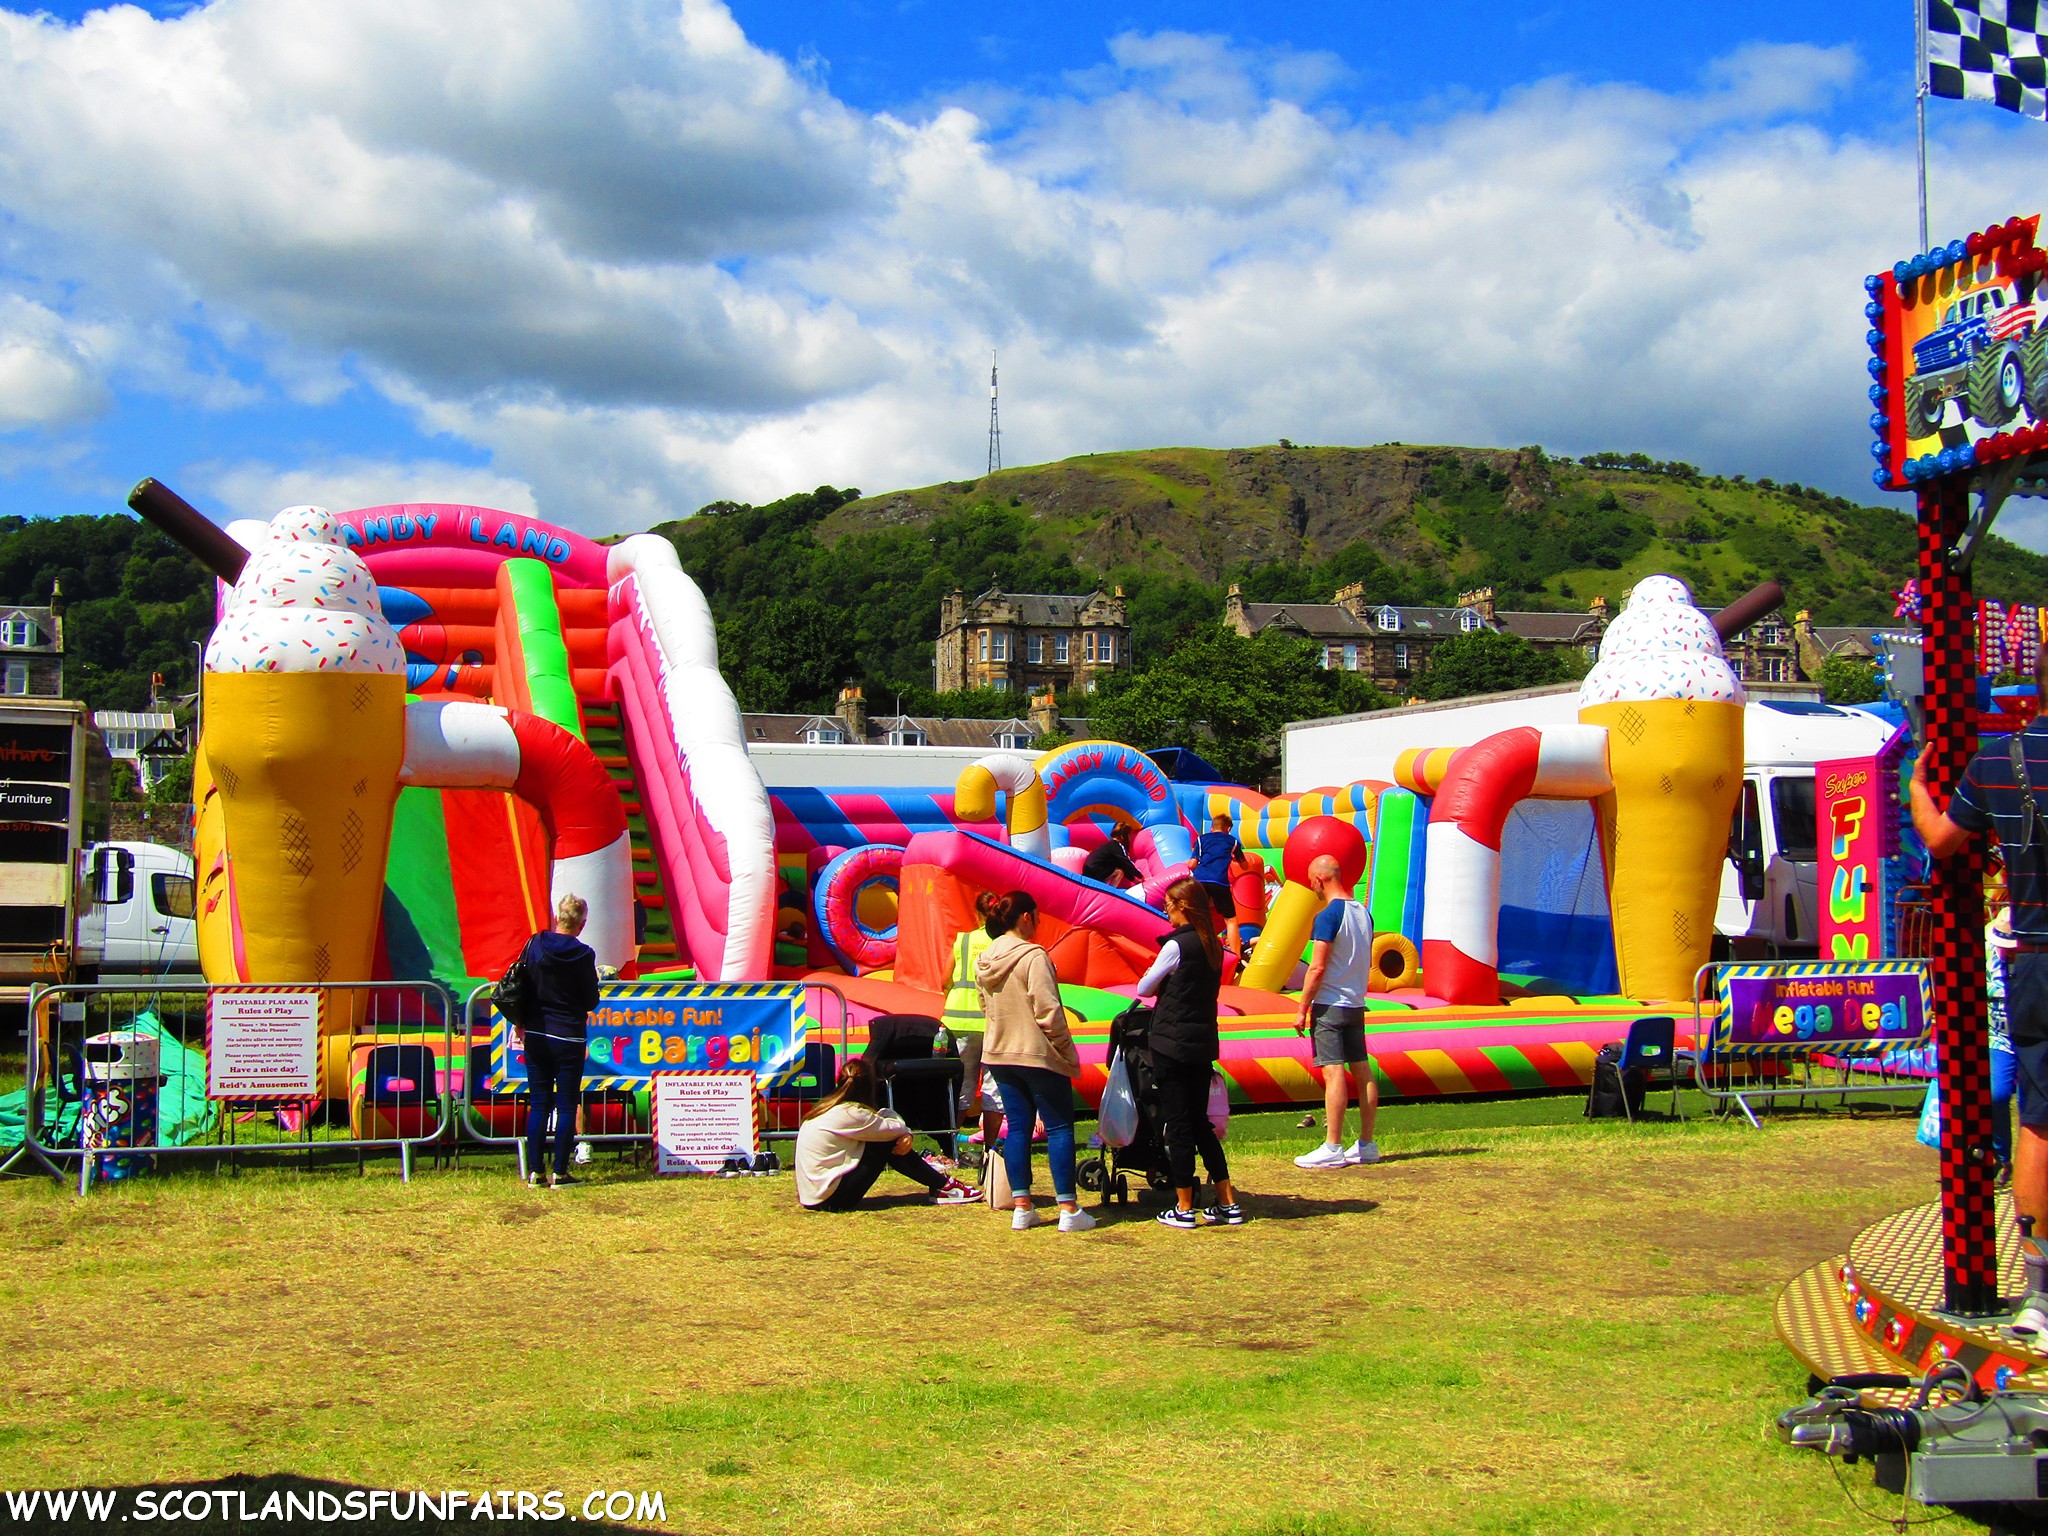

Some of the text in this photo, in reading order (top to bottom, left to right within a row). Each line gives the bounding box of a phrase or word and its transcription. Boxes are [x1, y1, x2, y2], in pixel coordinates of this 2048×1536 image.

[341, 514, 571, 564] ANDY LAND
[1044, 751, 1167, 802] CANDY LAND
[1825, 771, 1867, 799] Super
[0, 792, 52, 805] Furniture
[1776, 979, 1875, 998] Inflatable Fun!
[586, 1007, 723, 1027] nflatable Fun!
[1751, 995, 1908, 1039] Mega Deal
[639, 1026, 783, 1069] Bargain
